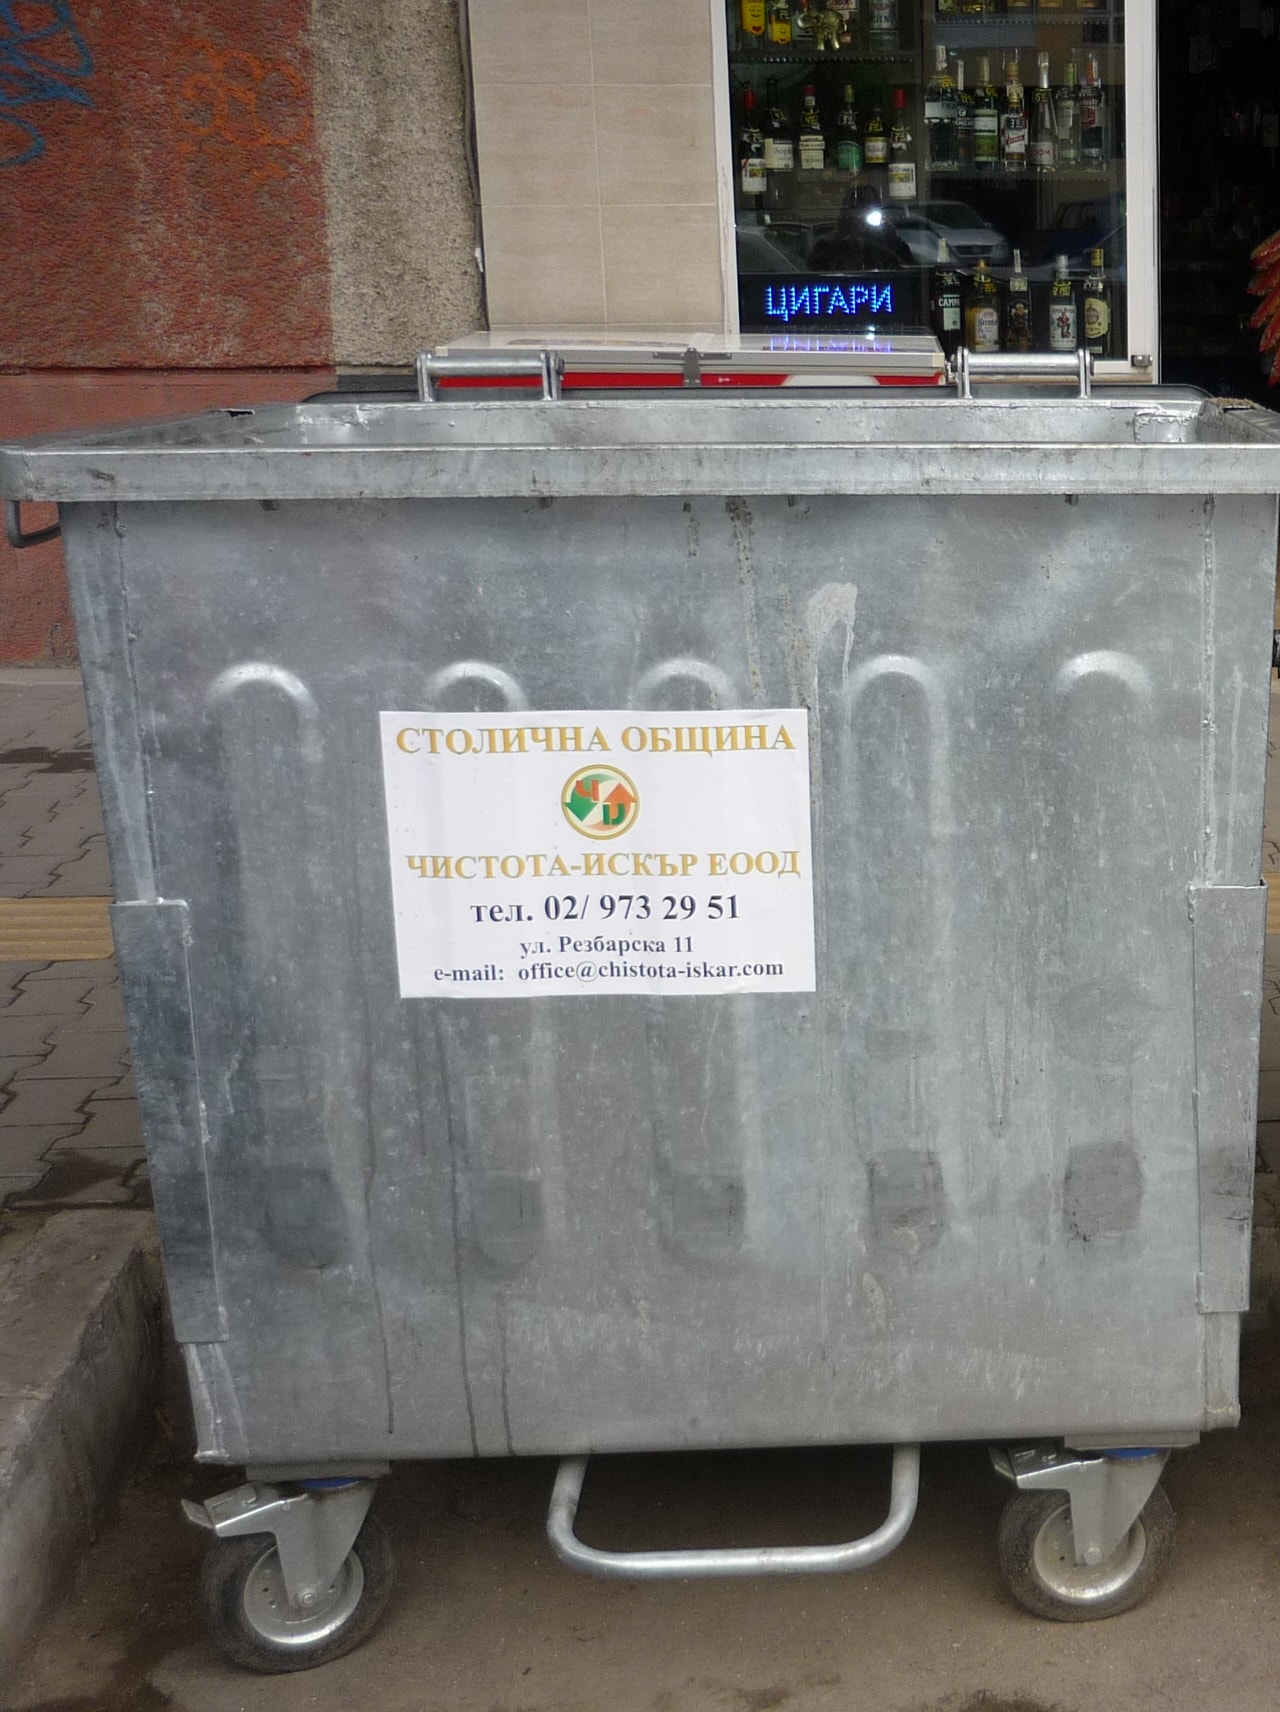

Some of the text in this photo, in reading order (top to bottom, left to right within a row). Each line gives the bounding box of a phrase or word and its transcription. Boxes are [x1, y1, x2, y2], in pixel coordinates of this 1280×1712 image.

[765, 284, 892, 322] ЦИГАРИ
[396, 724, 796, 758] СТОЛИЧНА ОБЩИНА
[406, 850, 801, 880] ЧИСТОТА-ИСКЪР ЕООД
[469, 894, 740, 923] тел. 02/ 973 29 51
[519, 935, 693, 960] ул. Резбарска 11
[433, 960, 784, 982] e-mail: office@chistota-iskar.com
